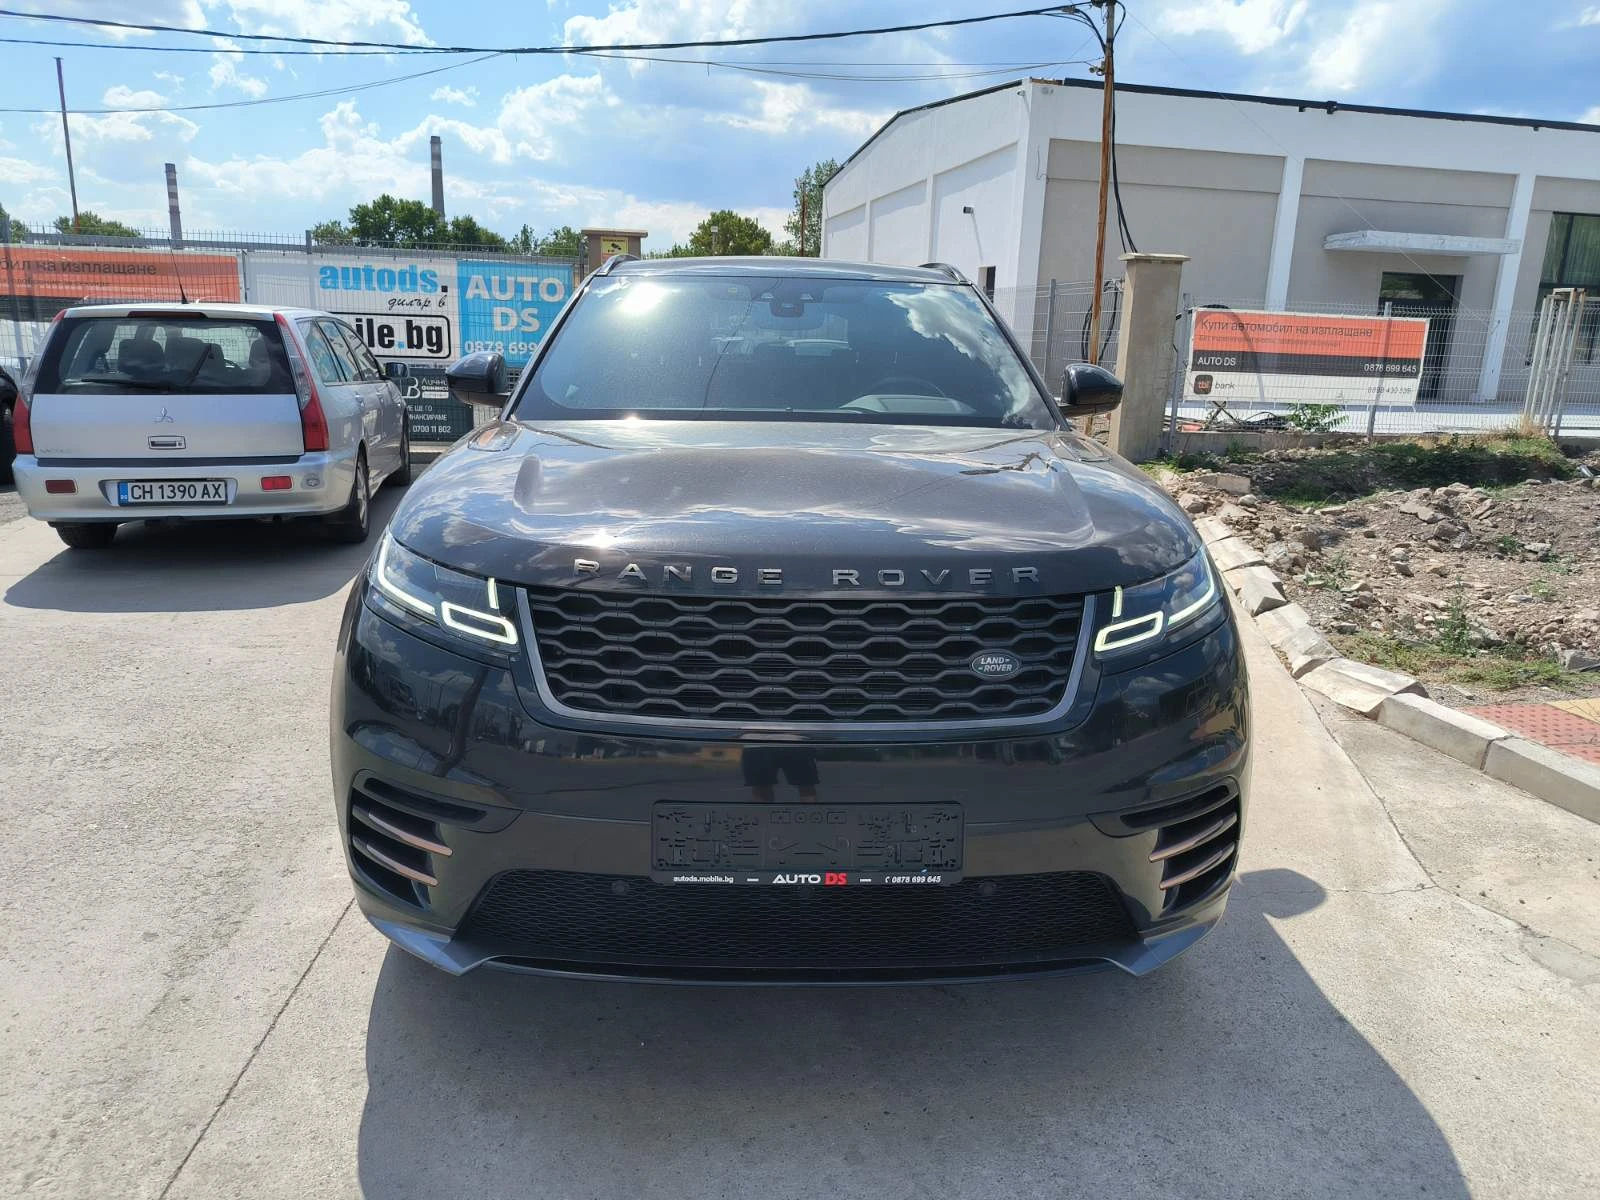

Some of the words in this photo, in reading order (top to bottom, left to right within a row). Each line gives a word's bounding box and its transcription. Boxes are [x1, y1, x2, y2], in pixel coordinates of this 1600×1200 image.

[61, 260, 157, 276] изплащане
[465, 274, 565, 302] AUTO
[493, 306, 541, 333] DS
[1201, 319, 1228, 331] Купи
[1231, 321, 1293, 332] автомобил
[1311, 326, 1373, 337] изплащане
[464, 340, 505, 356] 0878
[1198, 356, 1222, 366] AUTO
[1223, 357, 1237, 366] DS
[1363, 363, 1383, 372] 0878
[1385, 364, 1400, 373] 699
[1402, 364, 1417, 374] 645
[1214, 382, 1235, 390] bank
[412, 425, 430, 433] 0700
[431, 425, 437, 433] 11
[131, 484, 153, 500] CH
[158, 484, 197, 499] 1390
[201, 483, 223, 499] AX
[574, 558, 783, 585] RANGE
[832, 566, 1040, 586] ROVER
[673, 875, 734, 884] autods.mobile.bg
[772, 874, 821, 884] AUTO
[825, 872, 847, 885] DS
[891, 876, 910, 884] 0878
[911, 876, 926, 884] 699
[926, 875, 941, 883] 645
